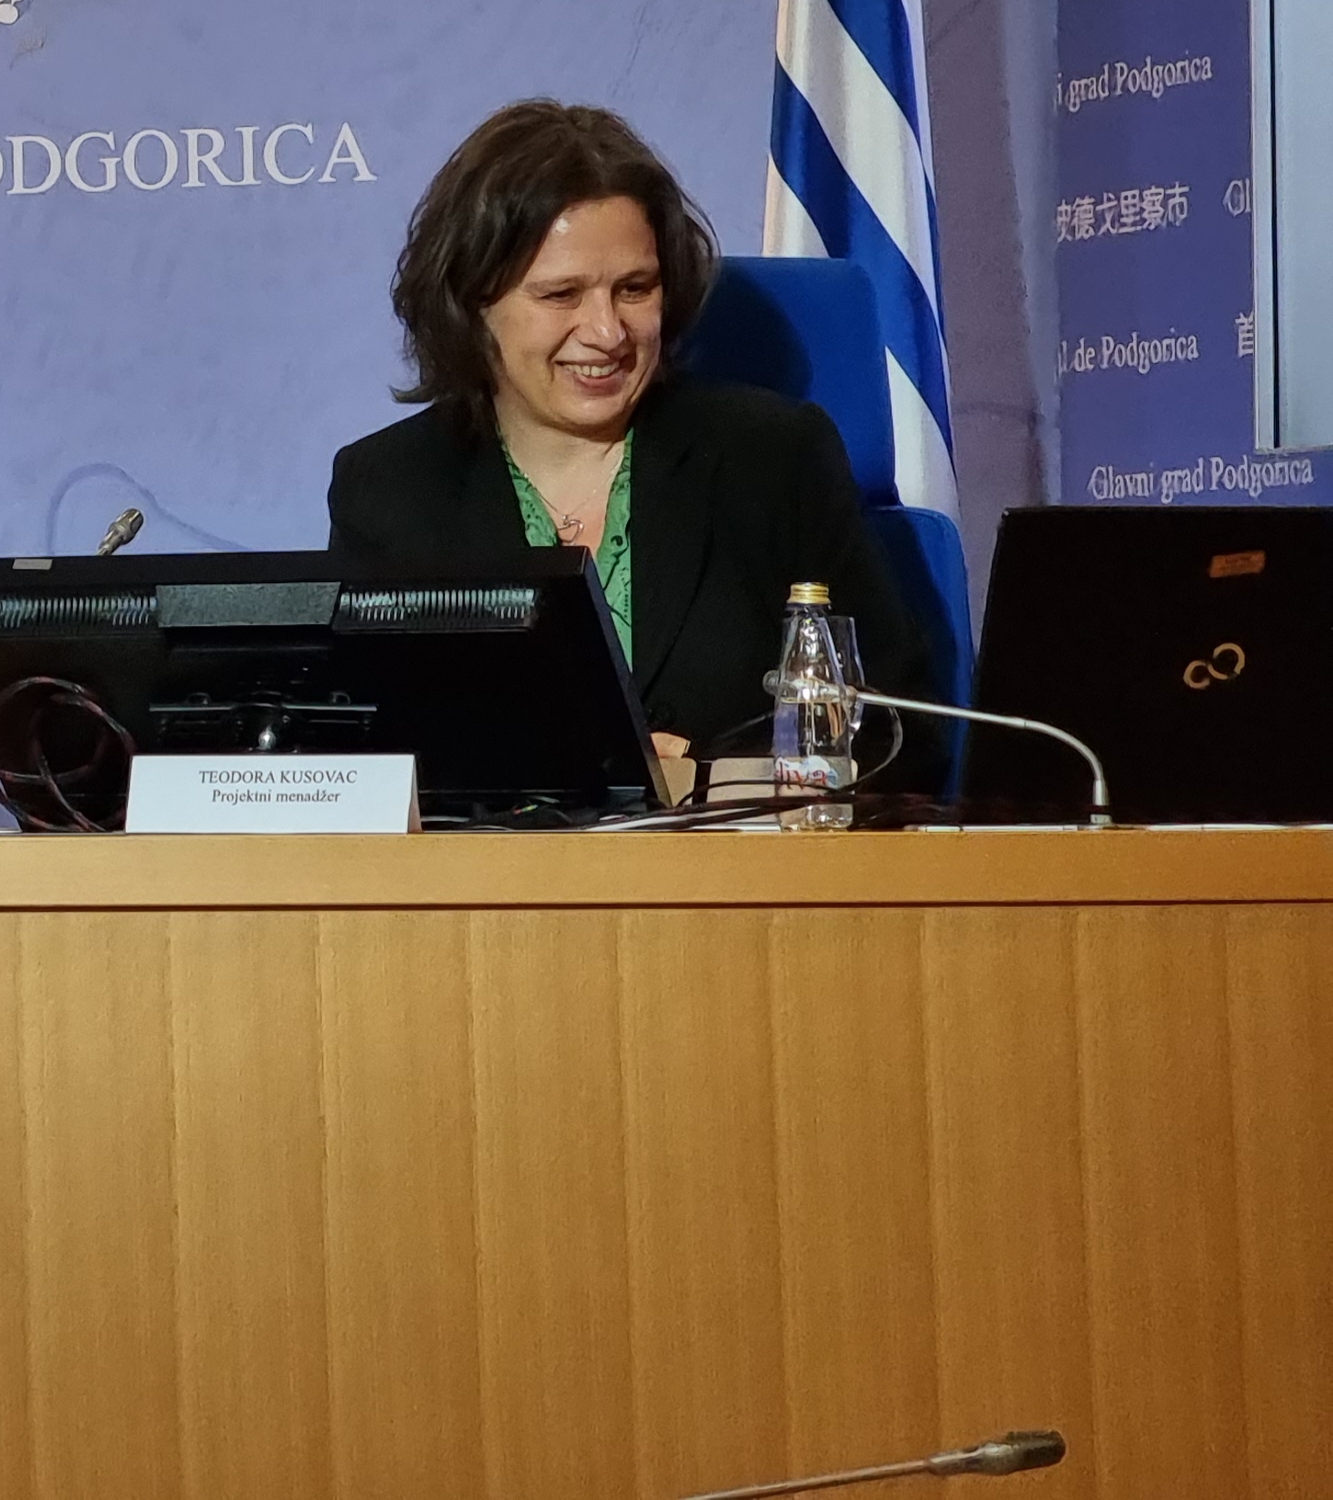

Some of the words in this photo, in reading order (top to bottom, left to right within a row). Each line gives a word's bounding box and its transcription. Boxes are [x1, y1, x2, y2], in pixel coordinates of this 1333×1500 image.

[1064, 63, 1109, 112] grad
[1114, 50, 1212, 98] Podgorica
[1071, 338, 1096, 373] de
[1101, 326, 1200, 375] Podgorica
[1088, 462, 1154, 500] Glavni
[1161, 459, 1204, 504] grad
[1210, 454, 1314, 497] Podgorica
[198, 770, 276, 784] TEODORA
[279, 770, 358, 784] KUSOVAC
[212, 789, 272, 806] Projektni
[276, 789, 341, 802] menadžer
